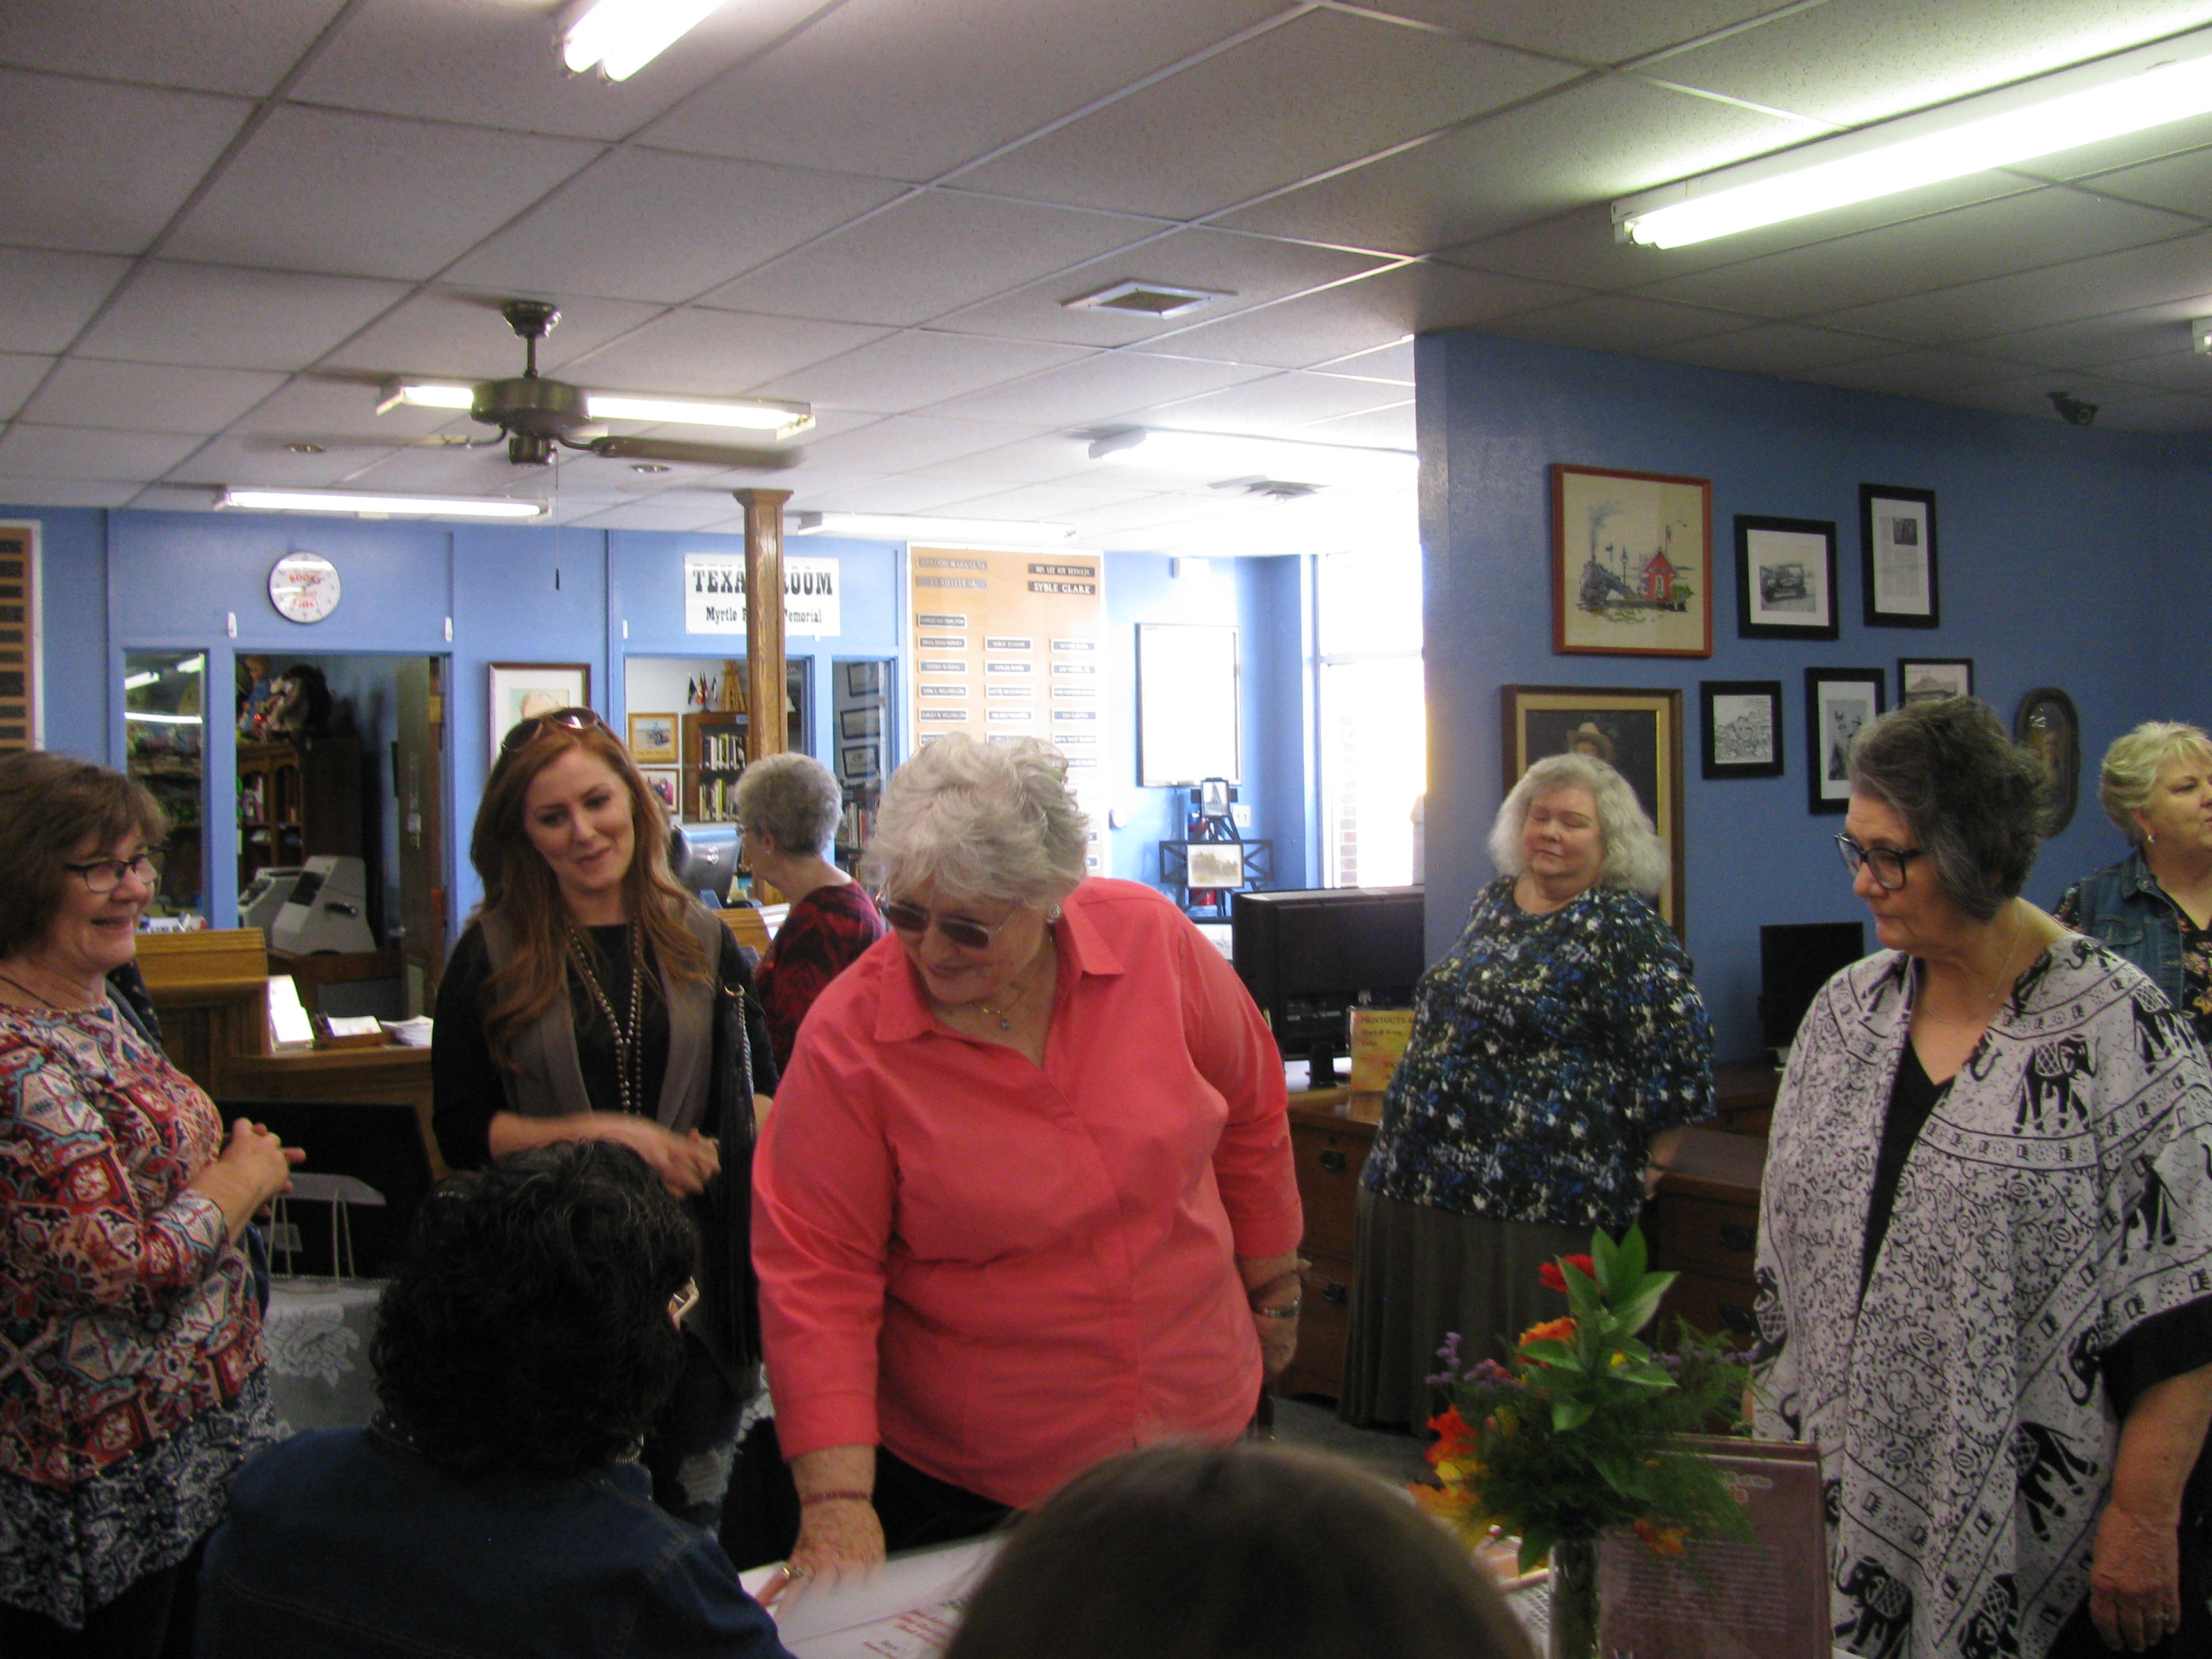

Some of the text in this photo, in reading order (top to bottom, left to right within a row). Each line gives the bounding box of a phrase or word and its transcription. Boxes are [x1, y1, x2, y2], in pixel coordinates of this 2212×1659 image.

[693, 570, 746, 593] TEXA
[1034, 582, 1091, 595] SYBLE CLARK
[706, 606, 737, 625] Myrtle
